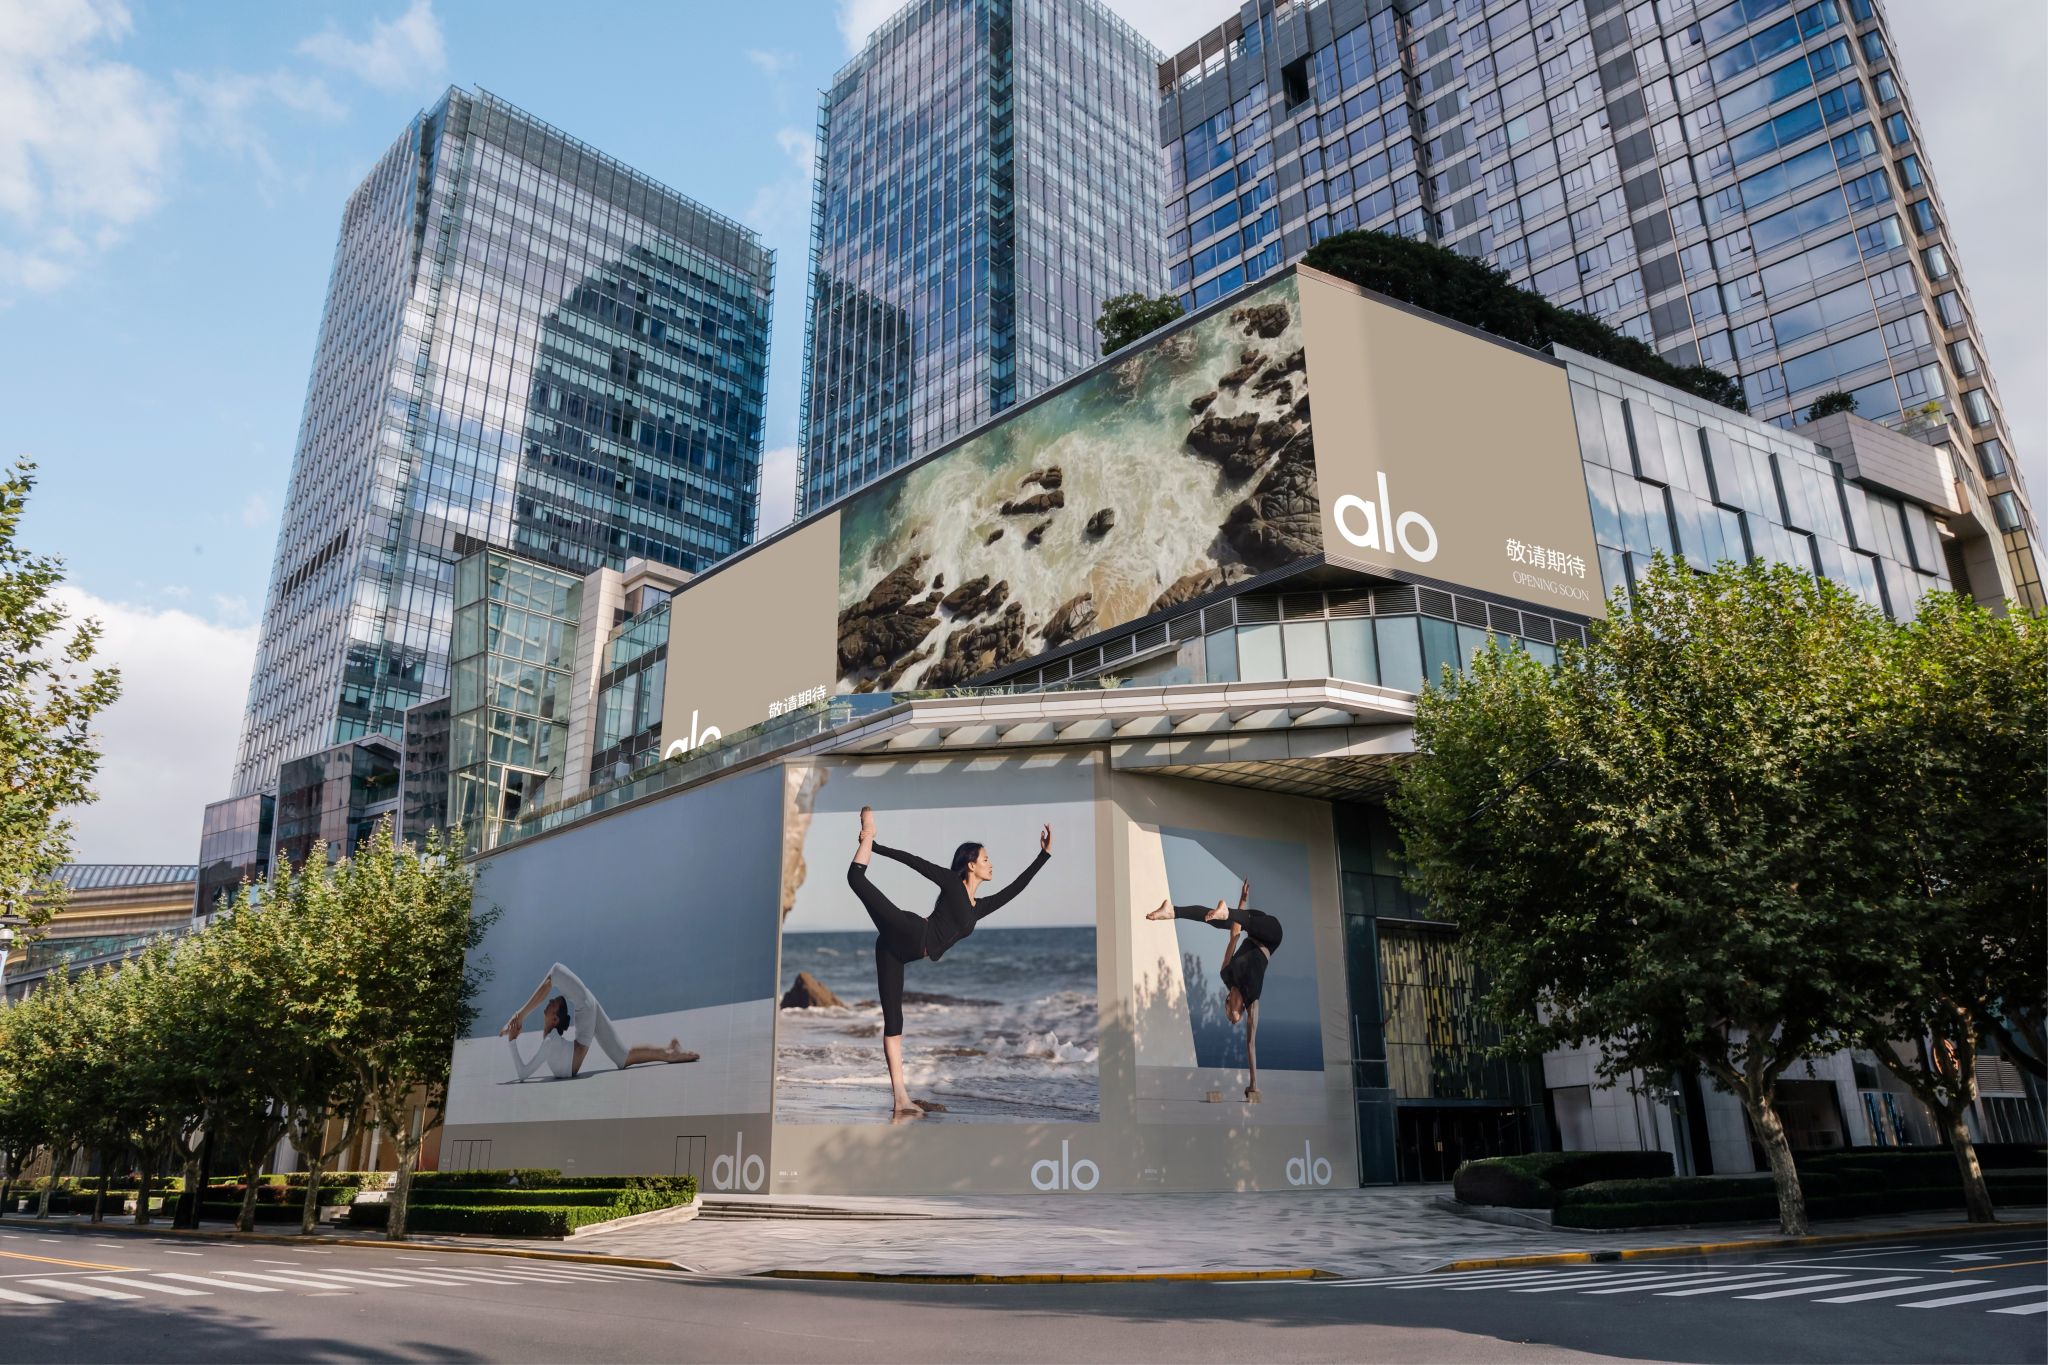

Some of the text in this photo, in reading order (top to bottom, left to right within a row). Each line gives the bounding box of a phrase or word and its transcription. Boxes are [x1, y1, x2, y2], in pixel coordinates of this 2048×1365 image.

[1333, 470, 1438, 563] alo
[1506, 537, 1586, 579] 敬请期待
[1512, 569, 1590, 602] OPENING SOON
[711, 1131, 765, 1191] alo
[1030, 1139, 1100, 1191] alo
[1285, 1139, 1332, 1186] alo
